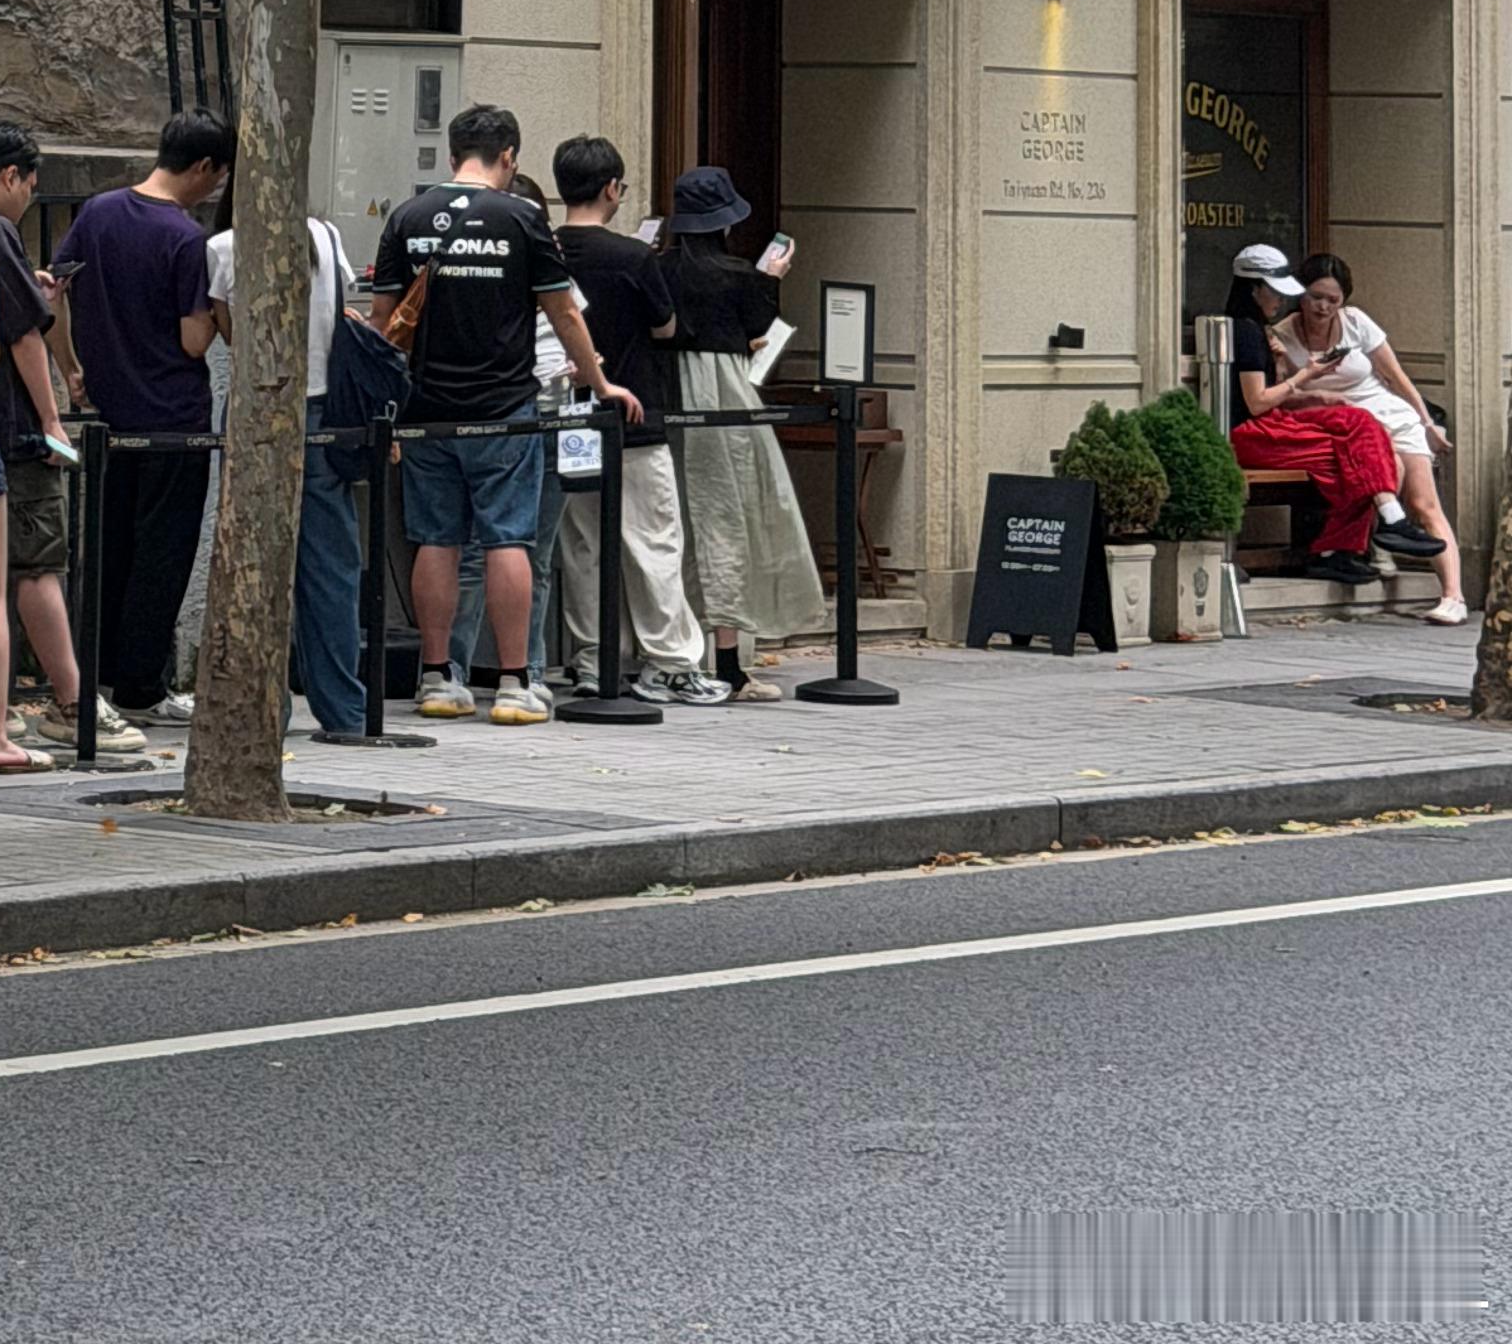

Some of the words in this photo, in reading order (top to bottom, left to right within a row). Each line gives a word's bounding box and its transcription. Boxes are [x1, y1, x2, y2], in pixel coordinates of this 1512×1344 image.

[1020, 111, 1086, 134] CAPTAIN
[1185, 81, 1270, 172] GEORGE
[1021, 138, 1085, 162] GEORGE
[406, 236, 510, 256] PETONAS
[1006, 516, 1066, 533] CAPTAIN
[1007, 530, 1062, 546] GEORGE
